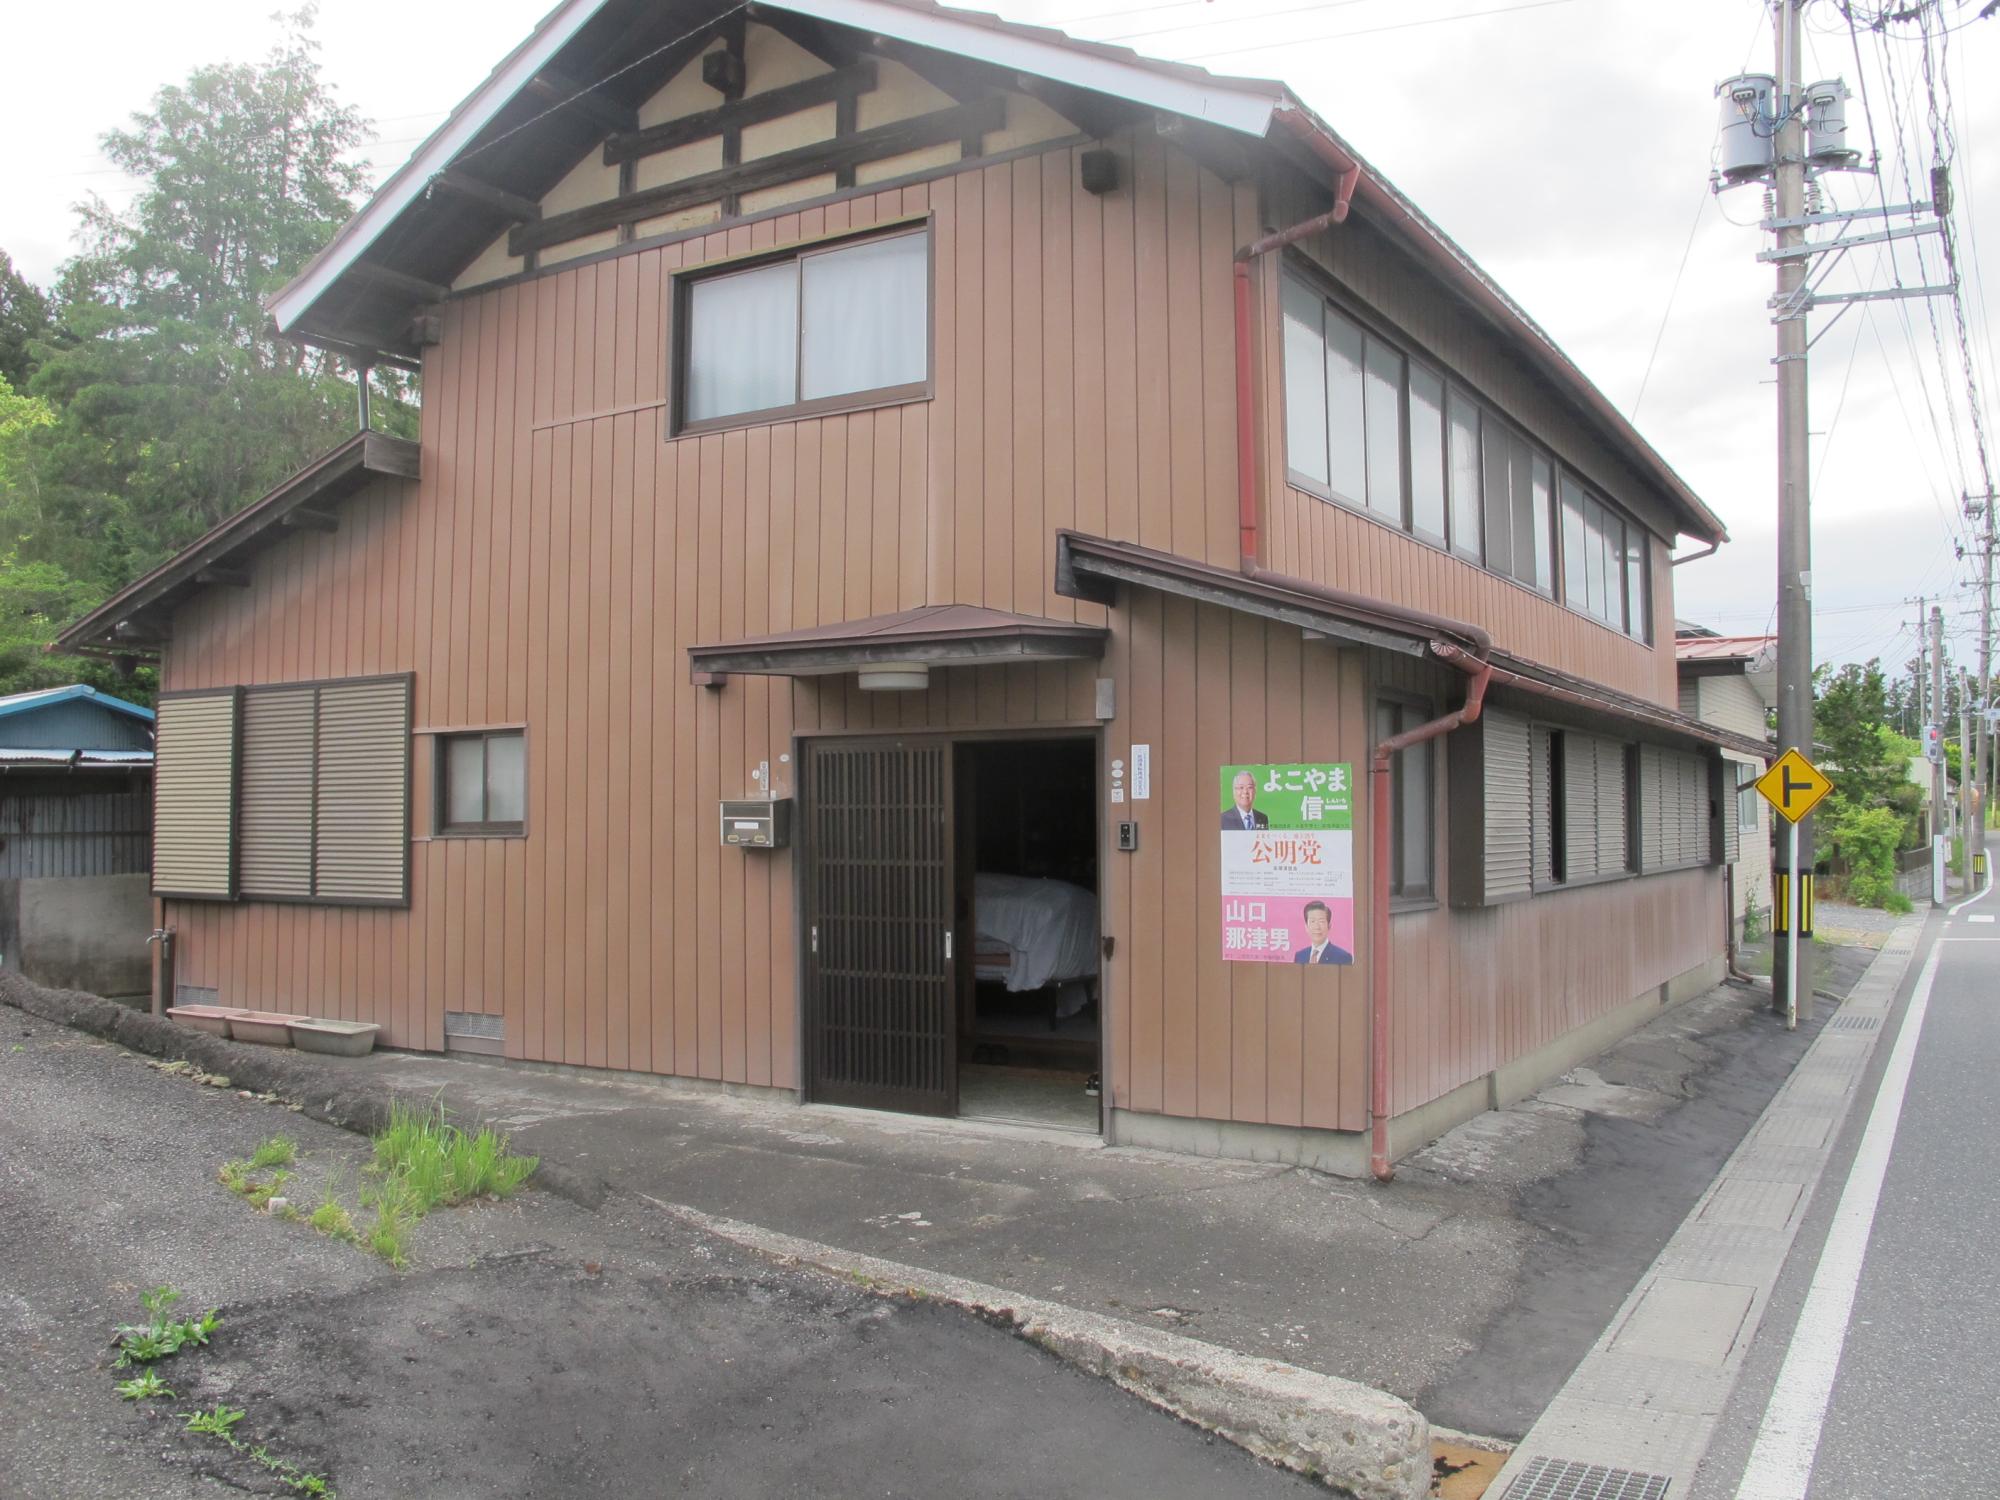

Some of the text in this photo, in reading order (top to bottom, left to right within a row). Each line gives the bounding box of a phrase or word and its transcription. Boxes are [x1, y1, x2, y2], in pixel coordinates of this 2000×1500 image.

[1264, 768, 1346, 792] よこやま
[1301, 796, 1348, 820] 信一
[1252, 840, 1322, 864] 公明党
[1226, 900, 1266, 922] 山口
[1226, 927, 1290, 950] 那津男
